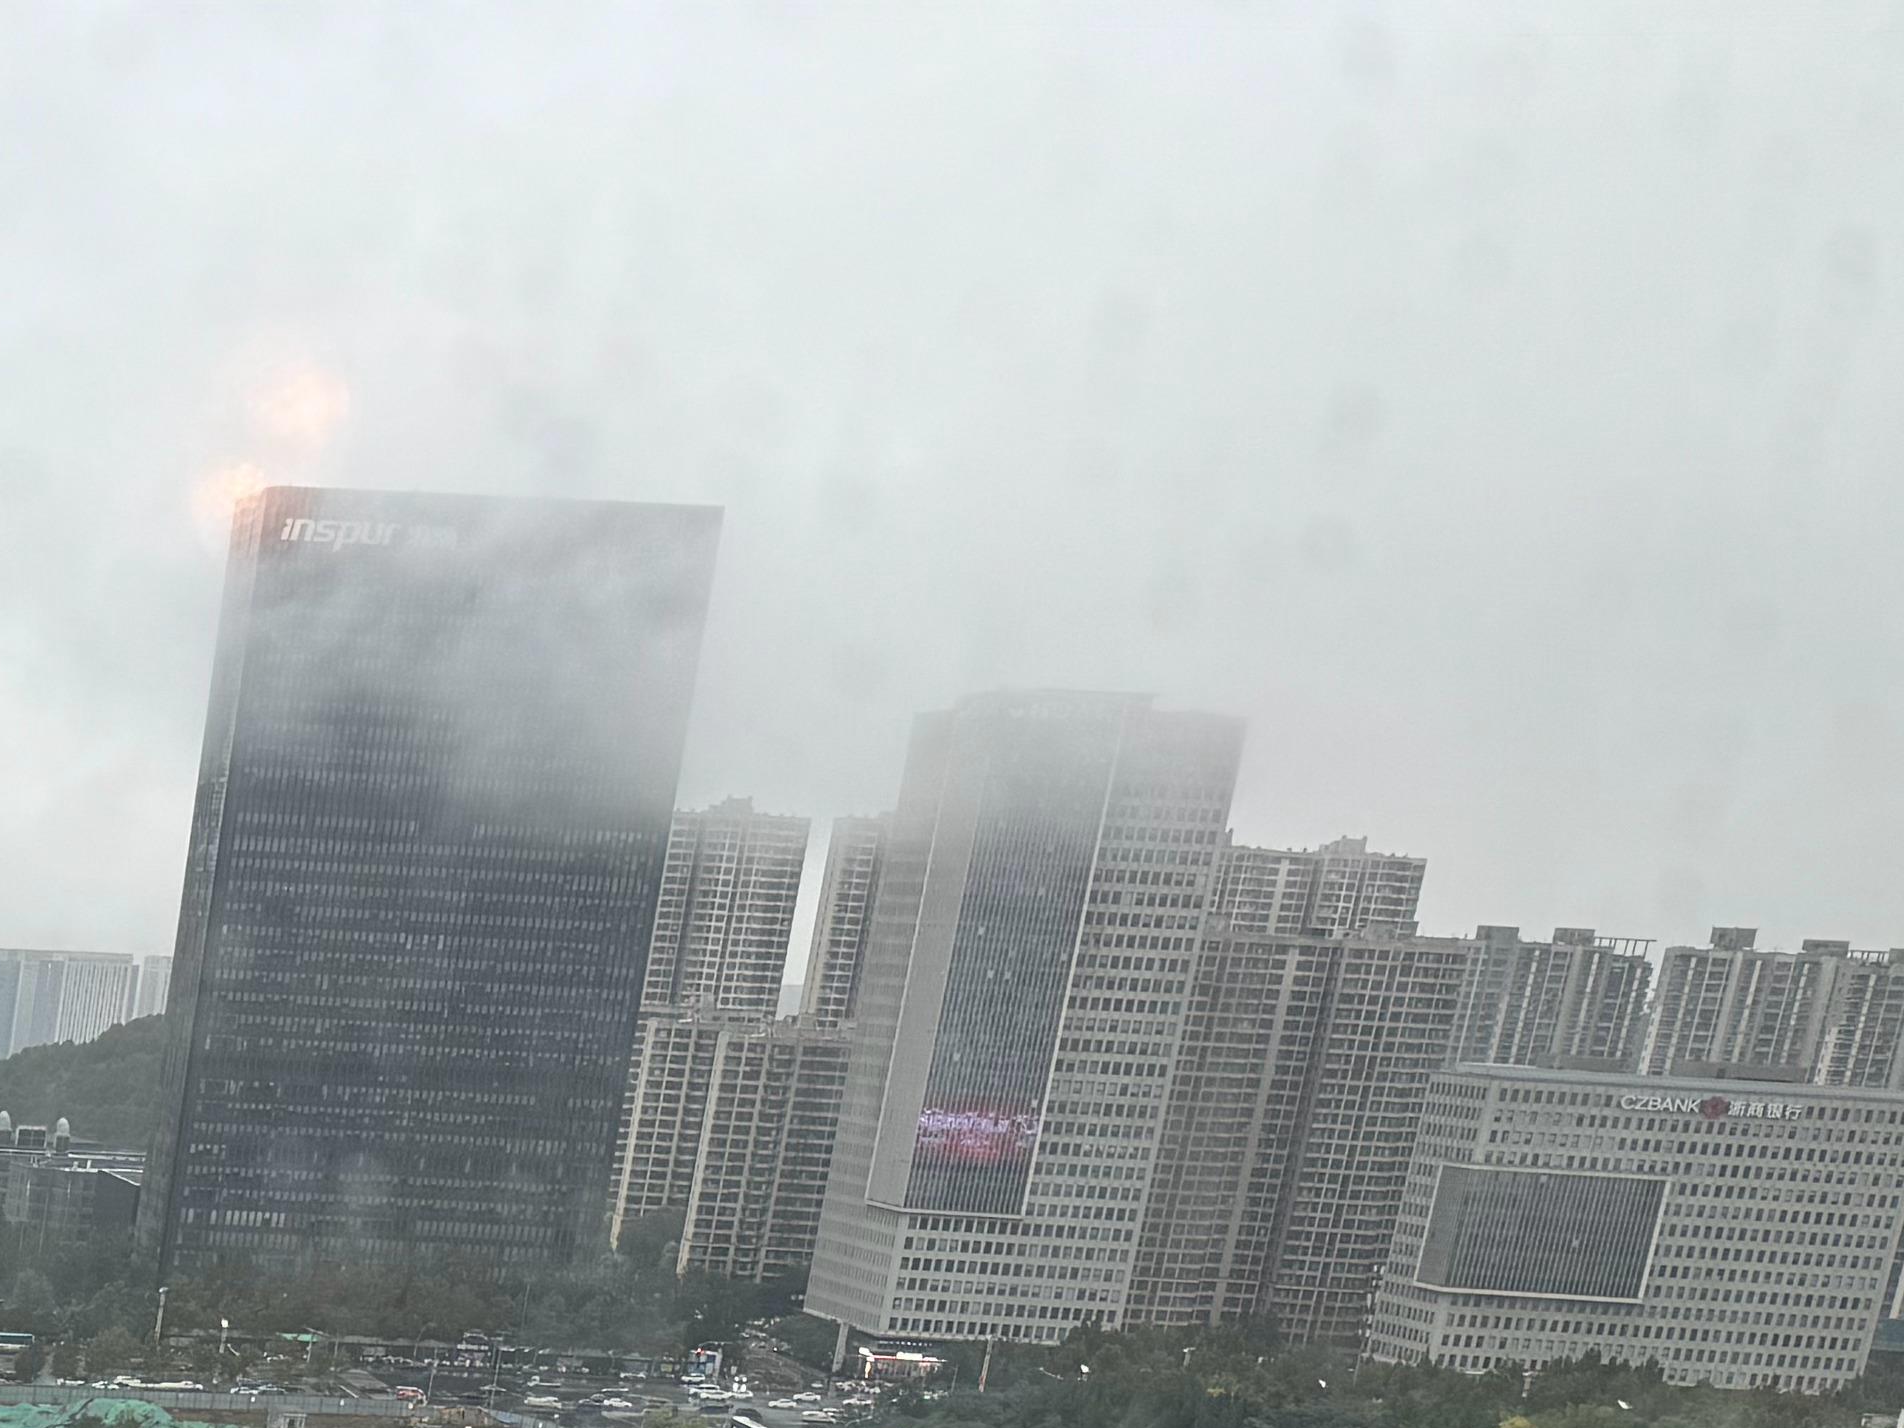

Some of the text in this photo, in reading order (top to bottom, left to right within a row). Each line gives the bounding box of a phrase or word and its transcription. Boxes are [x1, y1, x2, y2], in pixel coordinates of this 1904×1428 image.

[280, 518, 400, 551] inspur
[1620, 1095, 1803, 1120] CZBANK 浙商银行
